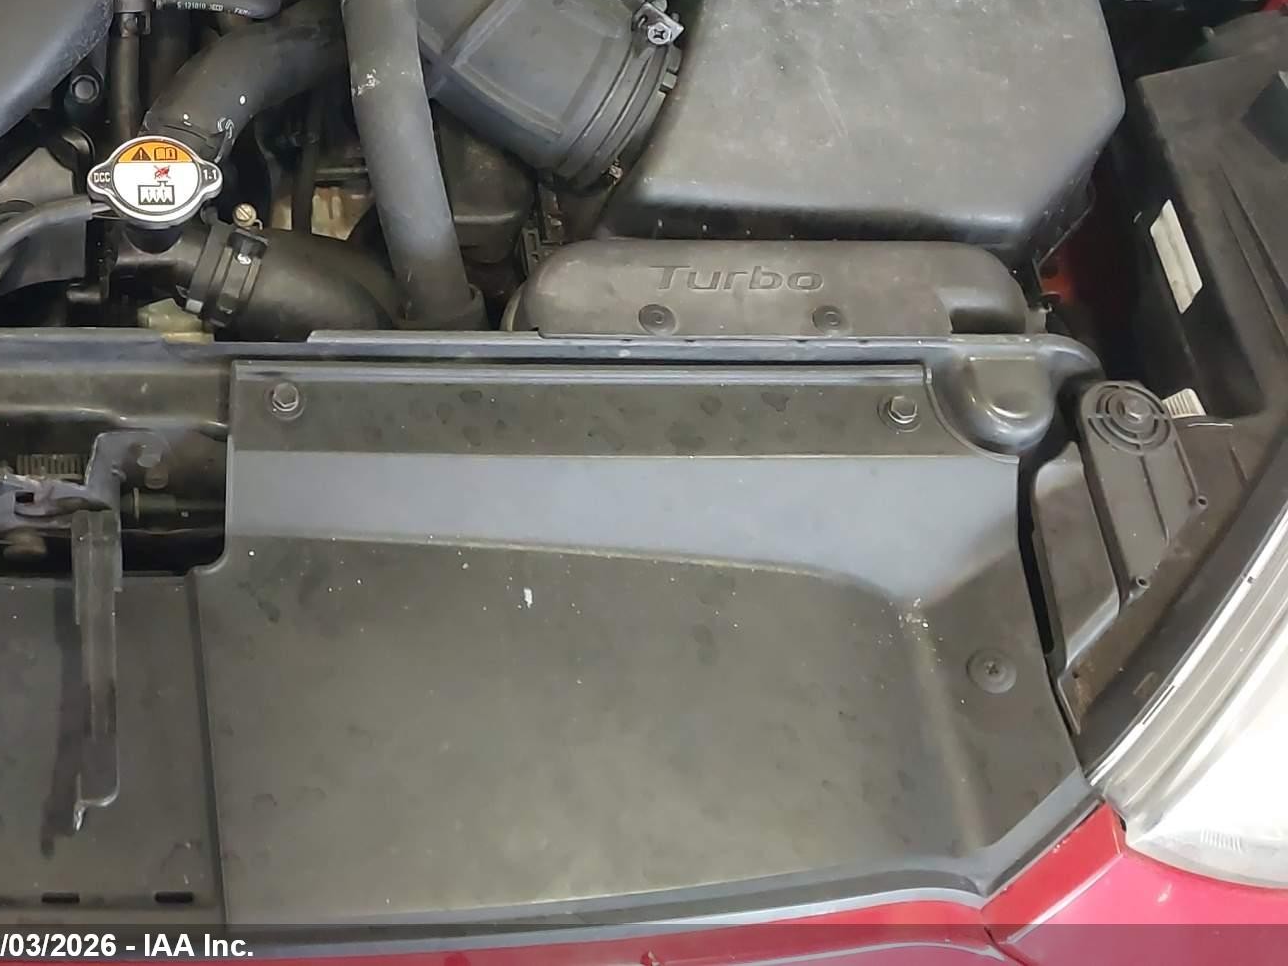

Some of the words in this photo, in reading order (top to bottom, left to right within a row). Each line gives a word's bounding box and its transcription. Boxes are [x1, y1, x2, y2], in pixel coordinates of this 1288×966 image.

[93, 172, 111, 183] DCC
[203, 169, 217, 181] 1.1
[649, 265, 824, 291] Turbo
